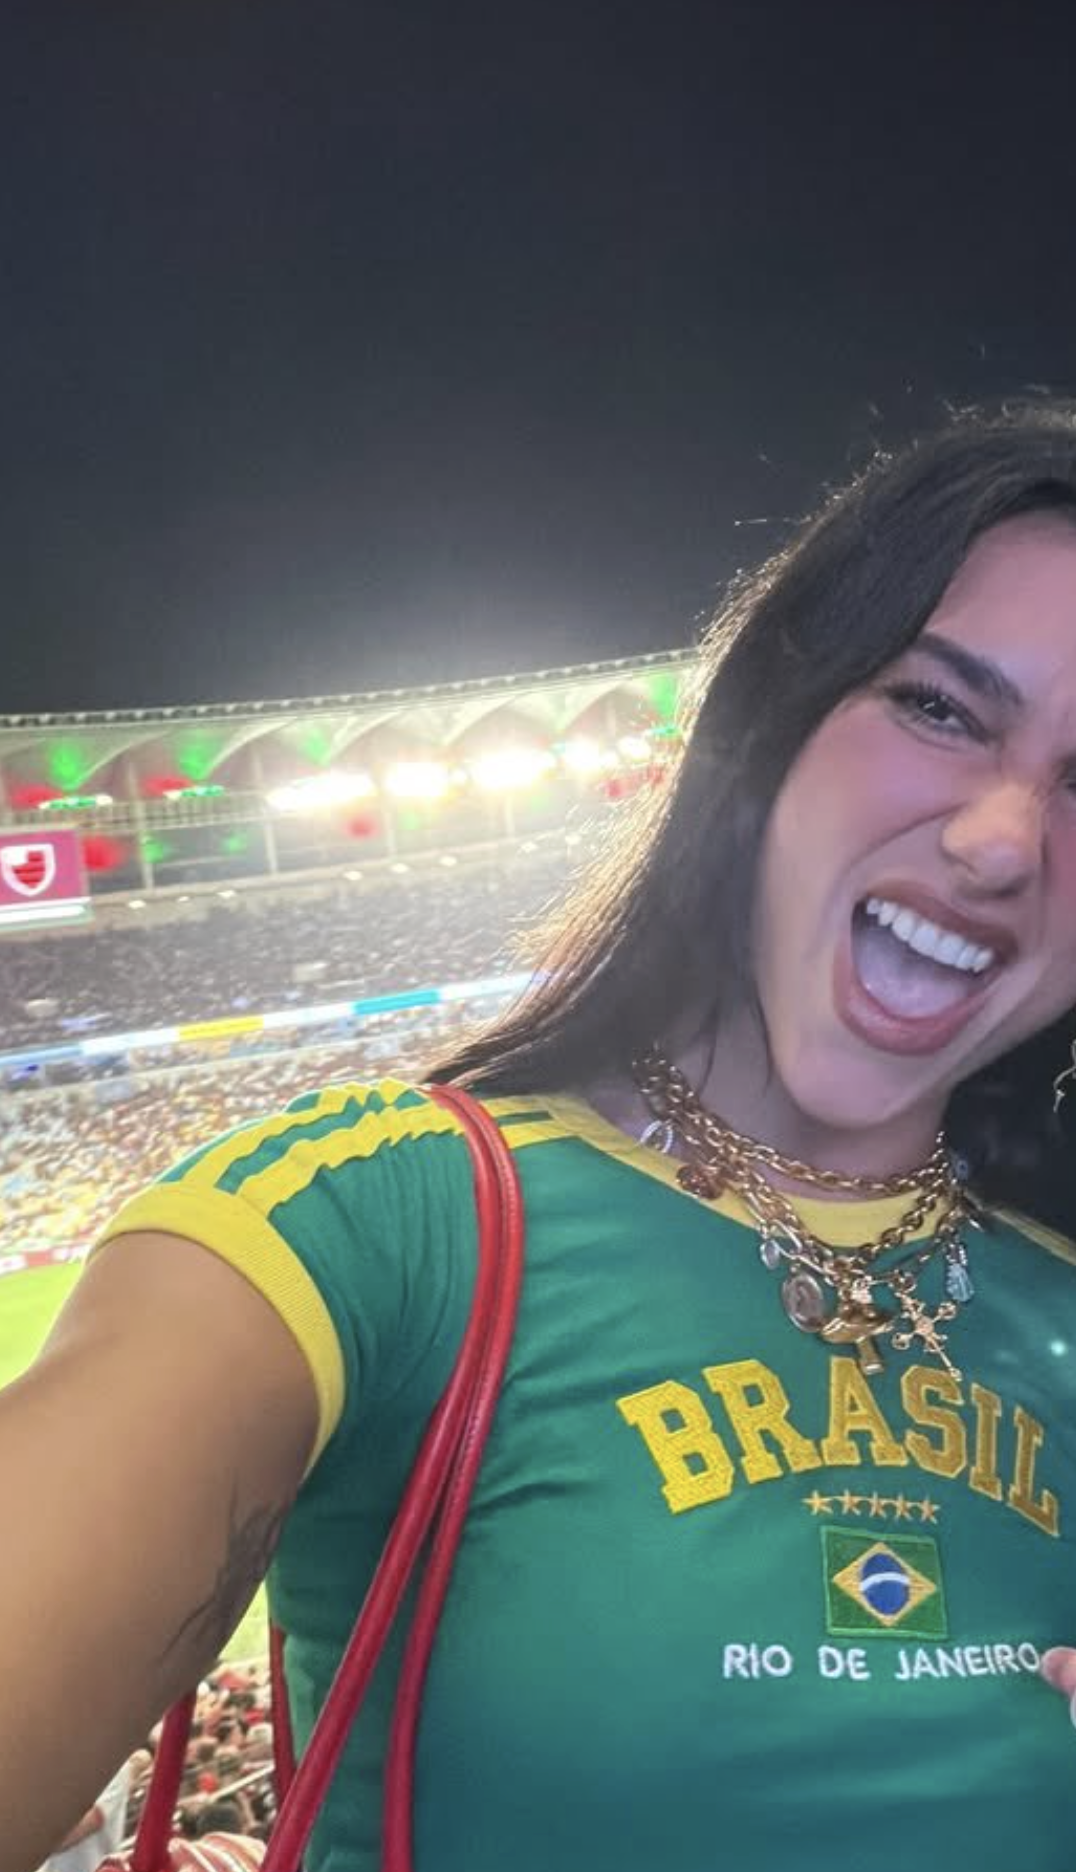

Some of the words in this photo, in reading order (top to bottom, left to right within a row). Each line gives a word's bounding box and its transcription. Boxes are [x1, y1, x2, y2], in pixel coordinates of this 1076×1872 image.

[617, 1356, 1060, 1537] BRASIL
[723, 1643, 793, 1679] RIO
[818, 1647, 871, 1680] DE
[895, 1643, 1040, 1679] JANEIRO
